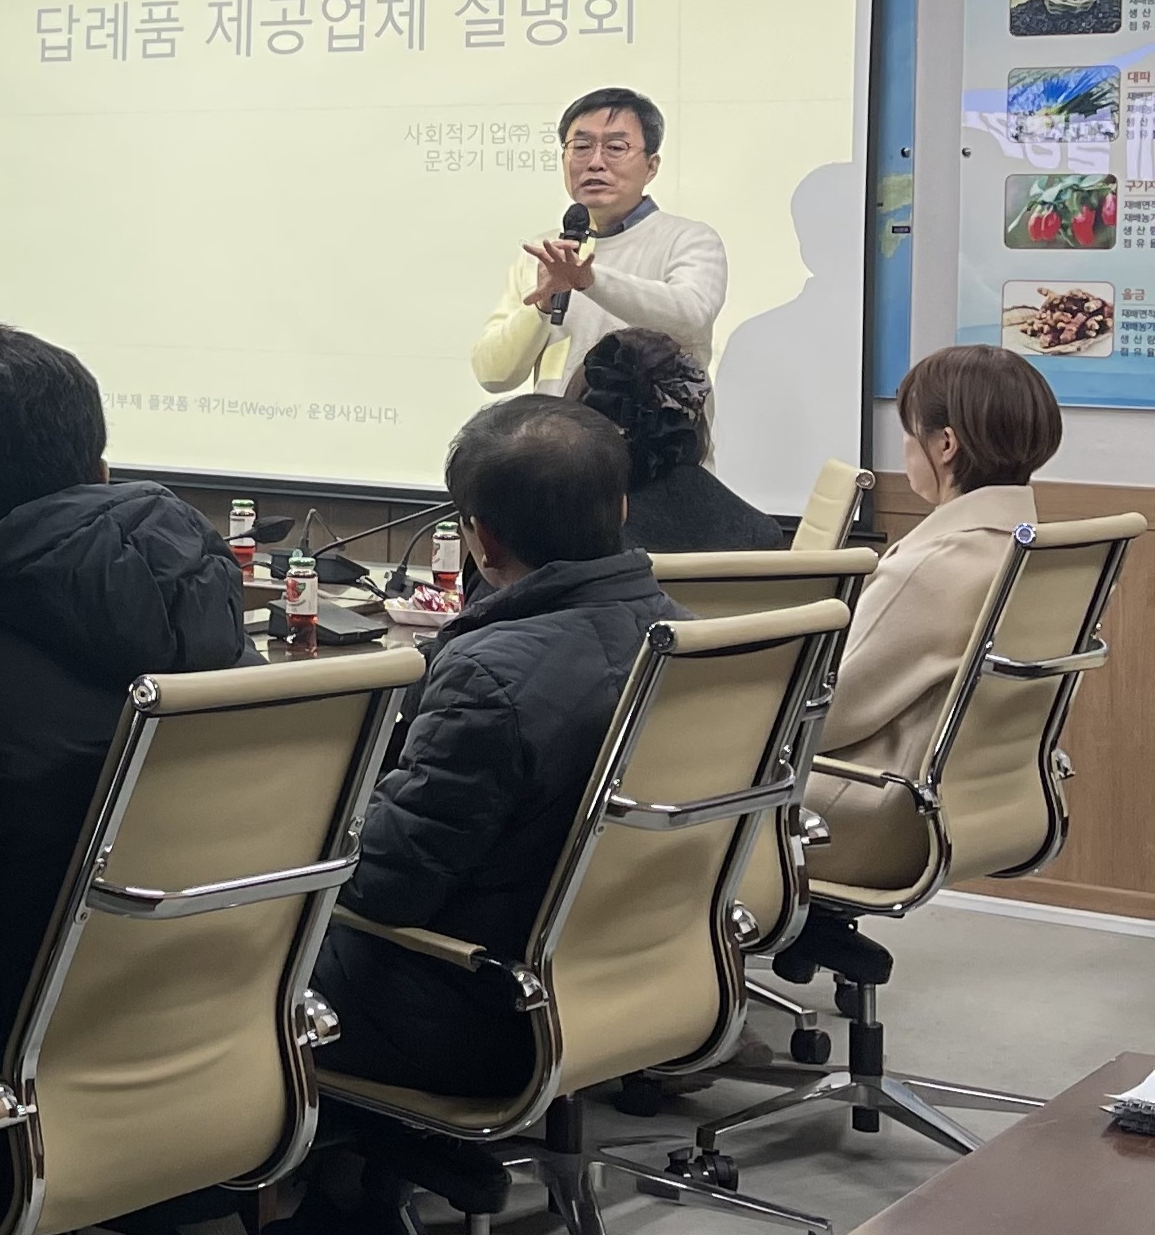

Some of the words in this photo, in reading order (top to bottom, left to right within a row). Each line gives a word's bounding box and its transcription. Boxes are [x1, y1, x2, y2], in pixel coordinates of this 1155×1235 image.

[36, 0, 185, 63] 답례품
[424, 149, 485, 172] 문창기
[495, 149, 559, 172] 대외협
[148, 394, 188, 412] 플랫폼
